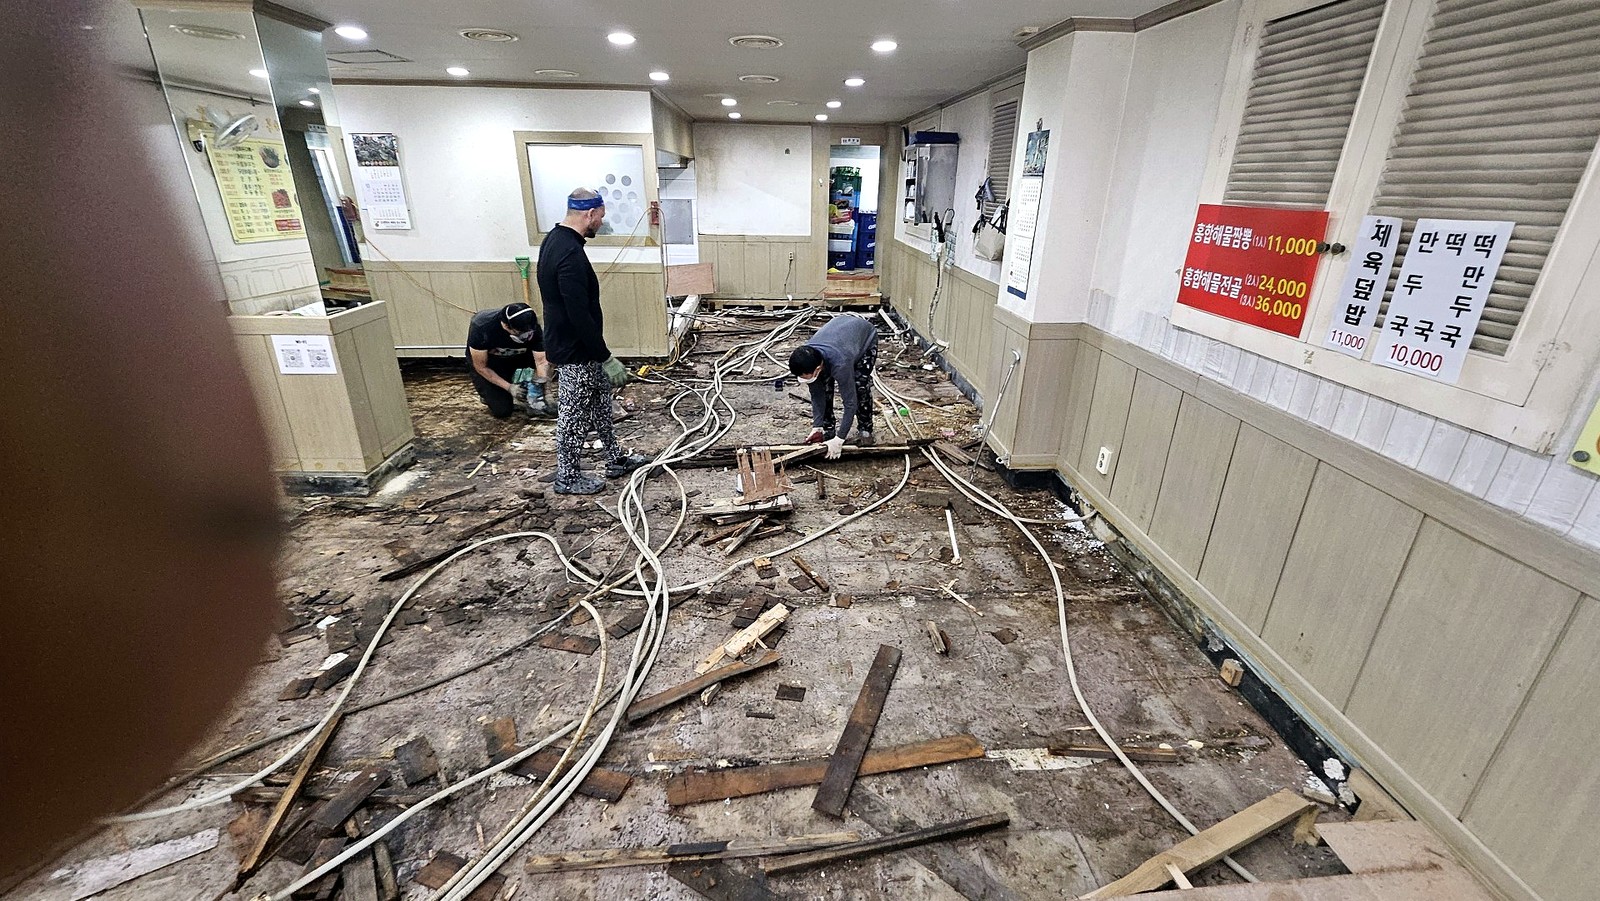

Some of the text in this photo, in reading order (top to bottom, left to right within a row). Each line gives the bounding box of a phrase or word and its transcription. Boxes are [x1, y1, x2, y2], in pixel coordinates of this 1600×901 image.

[1194, 222, 1253, 250] 홍합해물짬뽕
[1267, 235, 1317, 256] 11,000
[1183, 267, 1243, 299] 홍합해물전골
[1258, 275, 1307, 298] 24,000
[1344, 224, 1393, 327] 제육덮밥
[1255, 295, 1302, 320] 36,000
[1330, 329, 1365, 350] 11,000
[1390, 343, 1443, 372] 10,000
